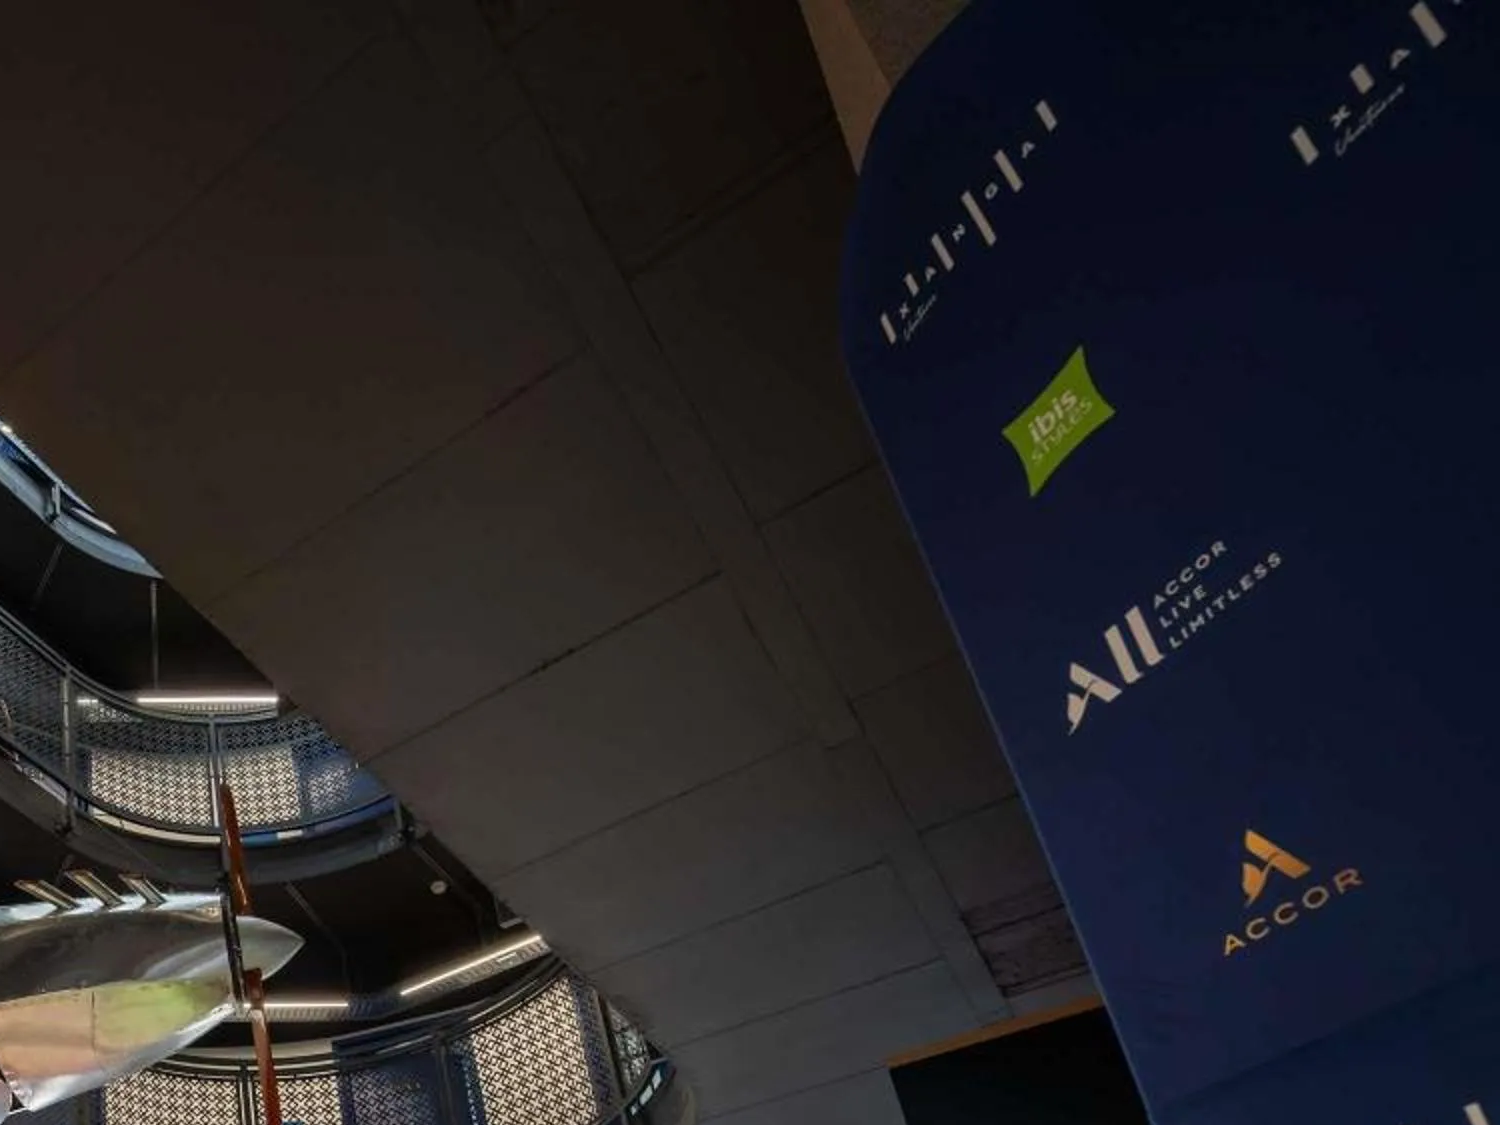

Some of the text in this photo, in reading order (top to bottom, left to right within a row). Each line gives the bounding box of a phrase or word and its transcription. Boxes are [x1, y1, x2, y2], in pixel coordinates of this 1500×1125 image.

[1028, 390, 1078, 443] ibis
[1153, 540, 1227, 610] ACCOR
[1159, 584, 1207, 629] LIVE
[1169, 552, 1282, 649] LIMITLESS
[1223, 867, 1364, 956] ACCOR
